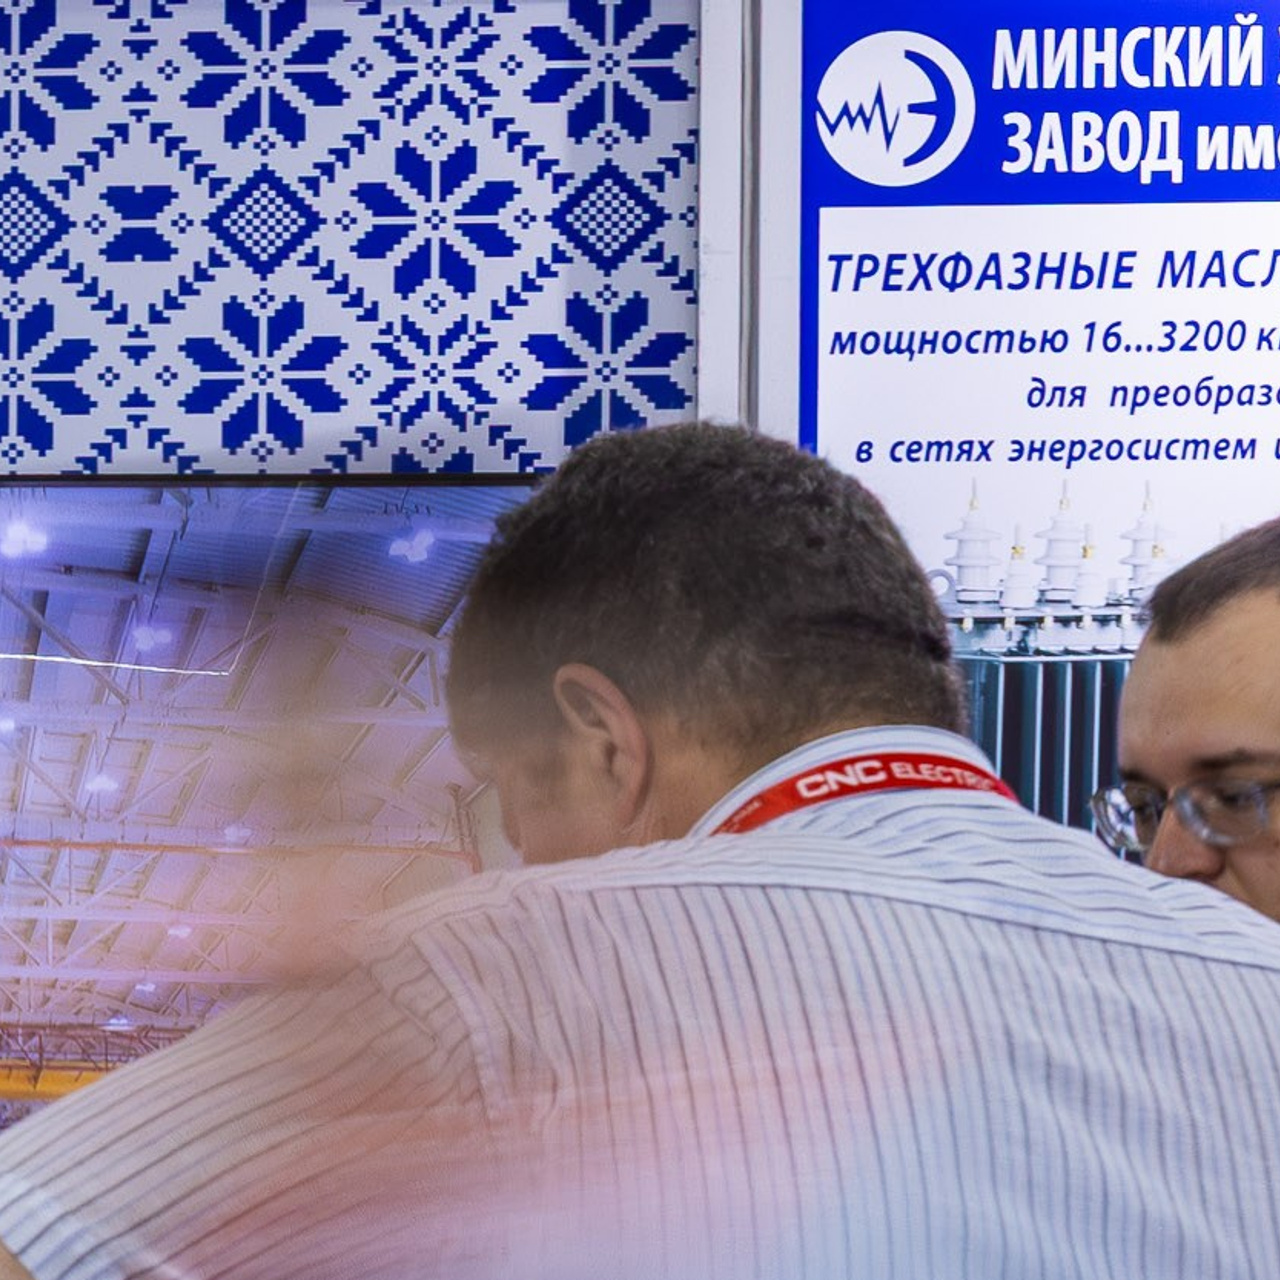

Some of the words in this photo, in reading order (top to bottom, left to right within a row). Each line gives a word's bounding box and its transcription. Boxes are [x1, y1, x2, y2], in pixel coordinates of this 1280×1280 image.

[991, 12, 1264, 90] МИНСКИЙ
[1001, 109, 1183, 185] ЗАВОД
[1196, 124, 1280, 171] им
[827, 250, 1138, 293] ТРЕХФАЗНЫЕ
[829, 328, 1069, 362] мощностью
[1084, 319, 1247, 353] 16...3200
[1026, 376, 1087, 409] для
[1109, 375, 1280, 416] преобраз
[855, 440, 874, 464] в
[889, 439, 995, 464] сетях
[1007, 437, 1257, 470] энергосистем
[796, 760, 888, 800] CNC
[889, 761, 995, 792] ELECTRIC
